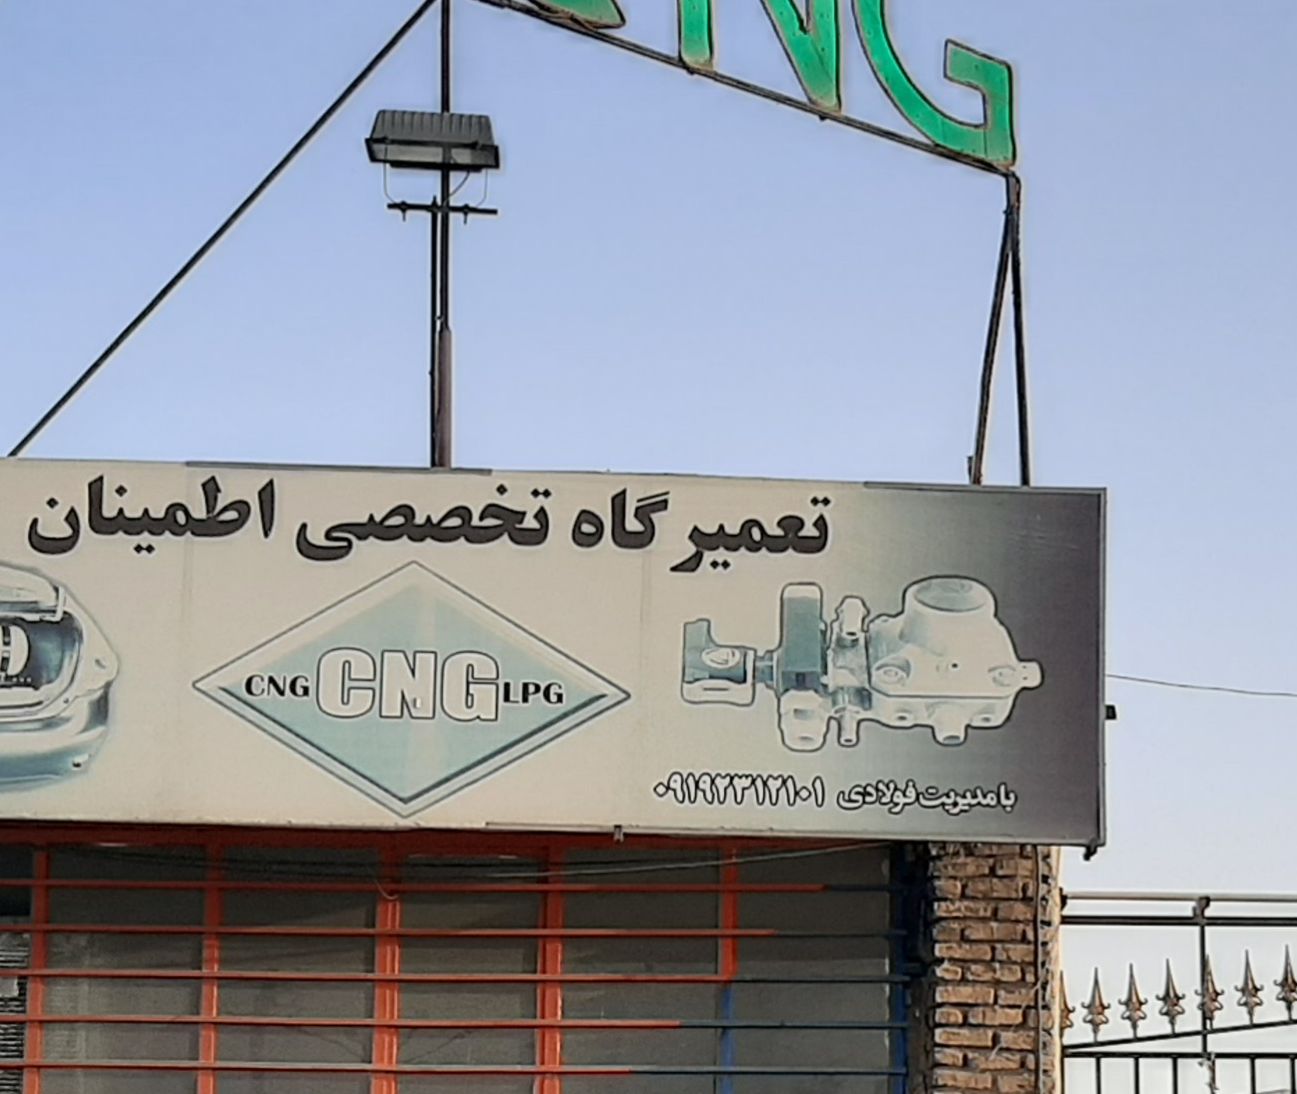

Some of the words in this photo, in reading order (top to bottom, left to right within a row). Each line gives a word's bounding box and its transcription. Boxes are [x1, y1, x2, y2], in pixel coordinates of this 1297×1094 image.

[27, 474, 275, 555] اطمینان
[296, 483, 552, 562] تخصصی
[244, 674, 310, 697] CNG
[316, 647, 500, 722] CNG
[503, 681, 564, 705] LPG
[836, 778, 917, 815] فولادی
